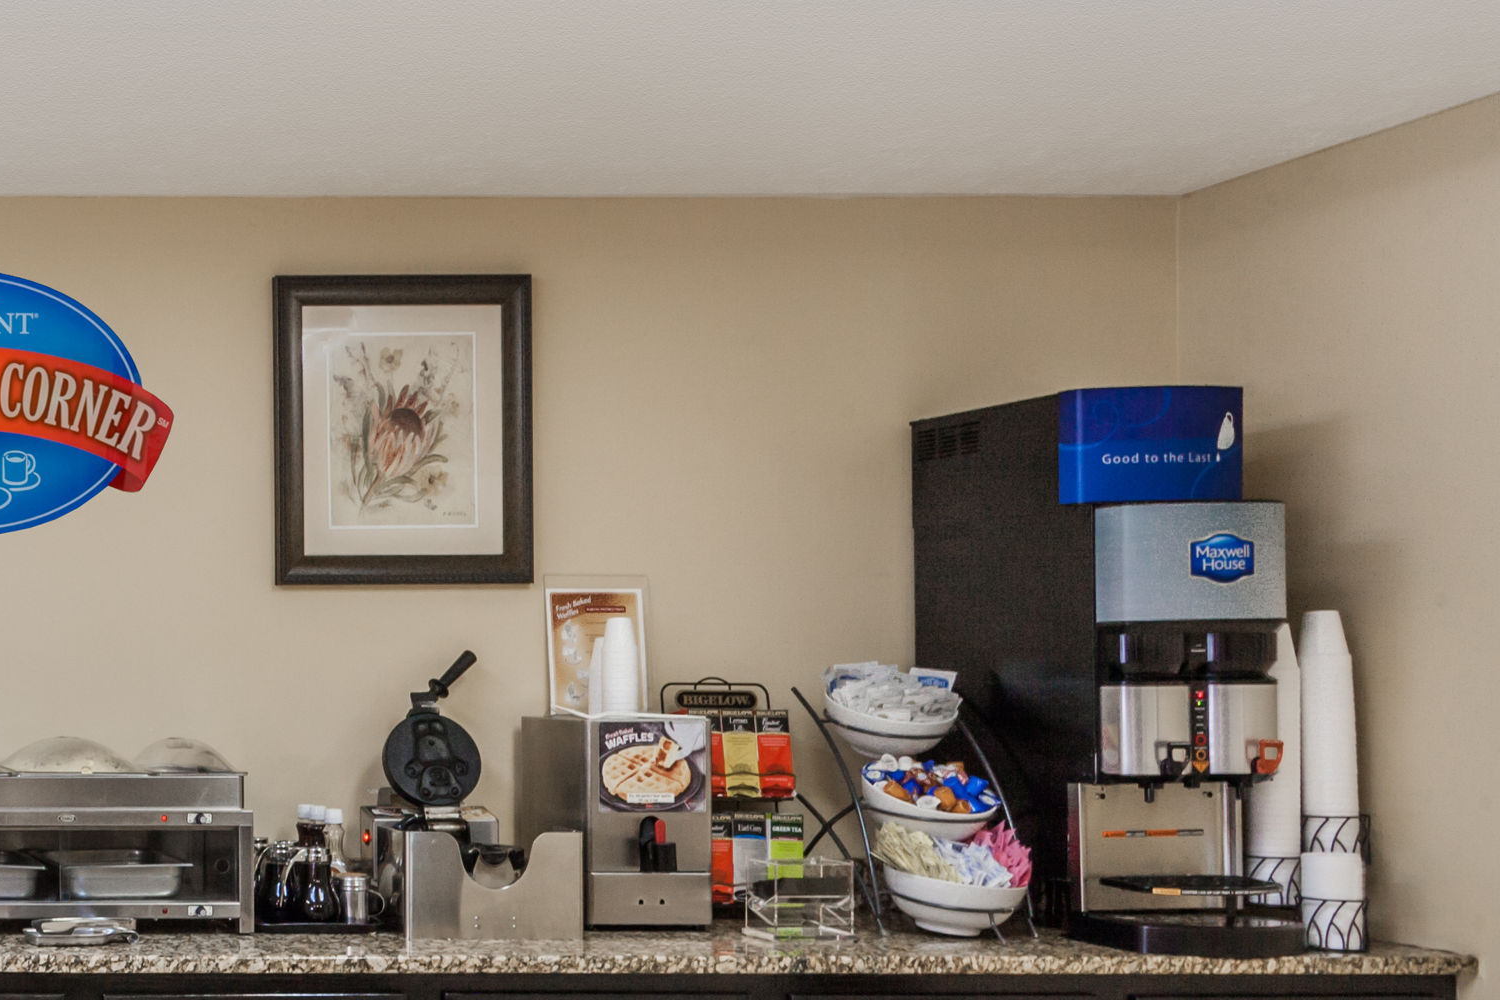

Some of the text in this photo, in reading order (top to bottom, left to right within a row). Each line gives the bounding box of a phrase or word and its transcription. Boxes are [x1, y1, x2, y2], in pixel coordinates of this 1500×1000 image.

[1, 362, 157, 462] CORNER
[1101, 451, 1211, 465] Good to the Last
[1195, 543, 1251, 572] Maxwell House
[555, 601, 572, 612] Fresh
[683, 694, 750, 706] BIGELOW
[604, 732, 654, 750] WAFFLES
